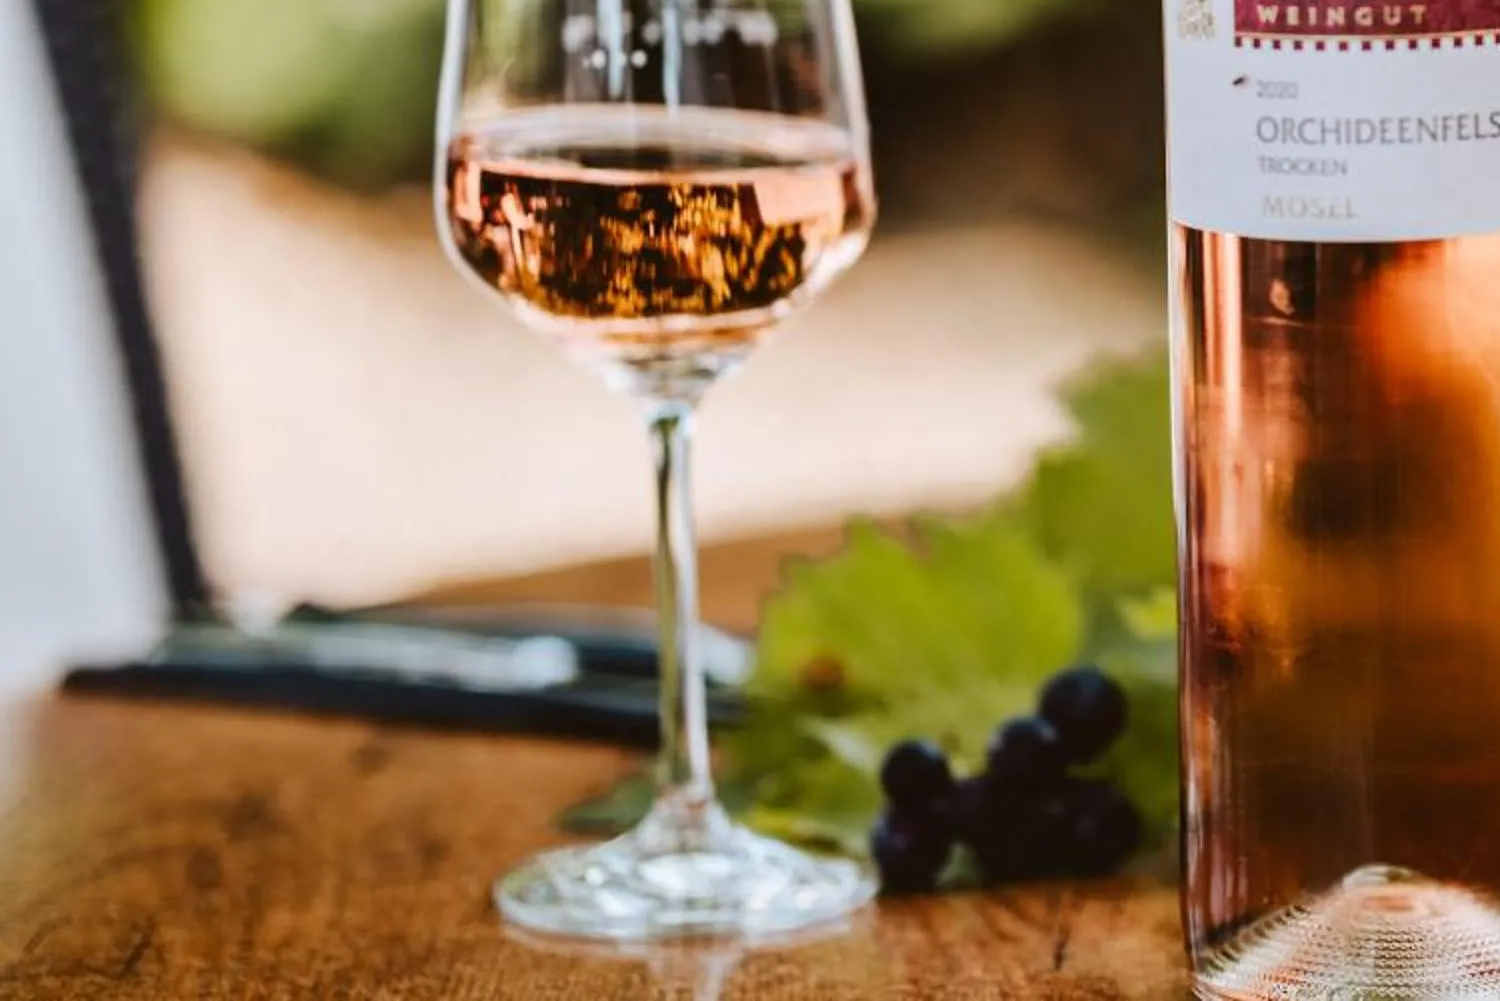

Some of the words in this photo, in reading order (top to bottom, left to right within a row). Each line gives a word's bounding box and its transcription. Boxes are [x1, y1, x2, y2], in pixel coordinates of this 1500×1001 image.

[1256, 4, 1428, 28] WEINGUT
[1258, 155, 1349, 178] TROCKEN
[1262, 196, 1359, 219] MOSEL
